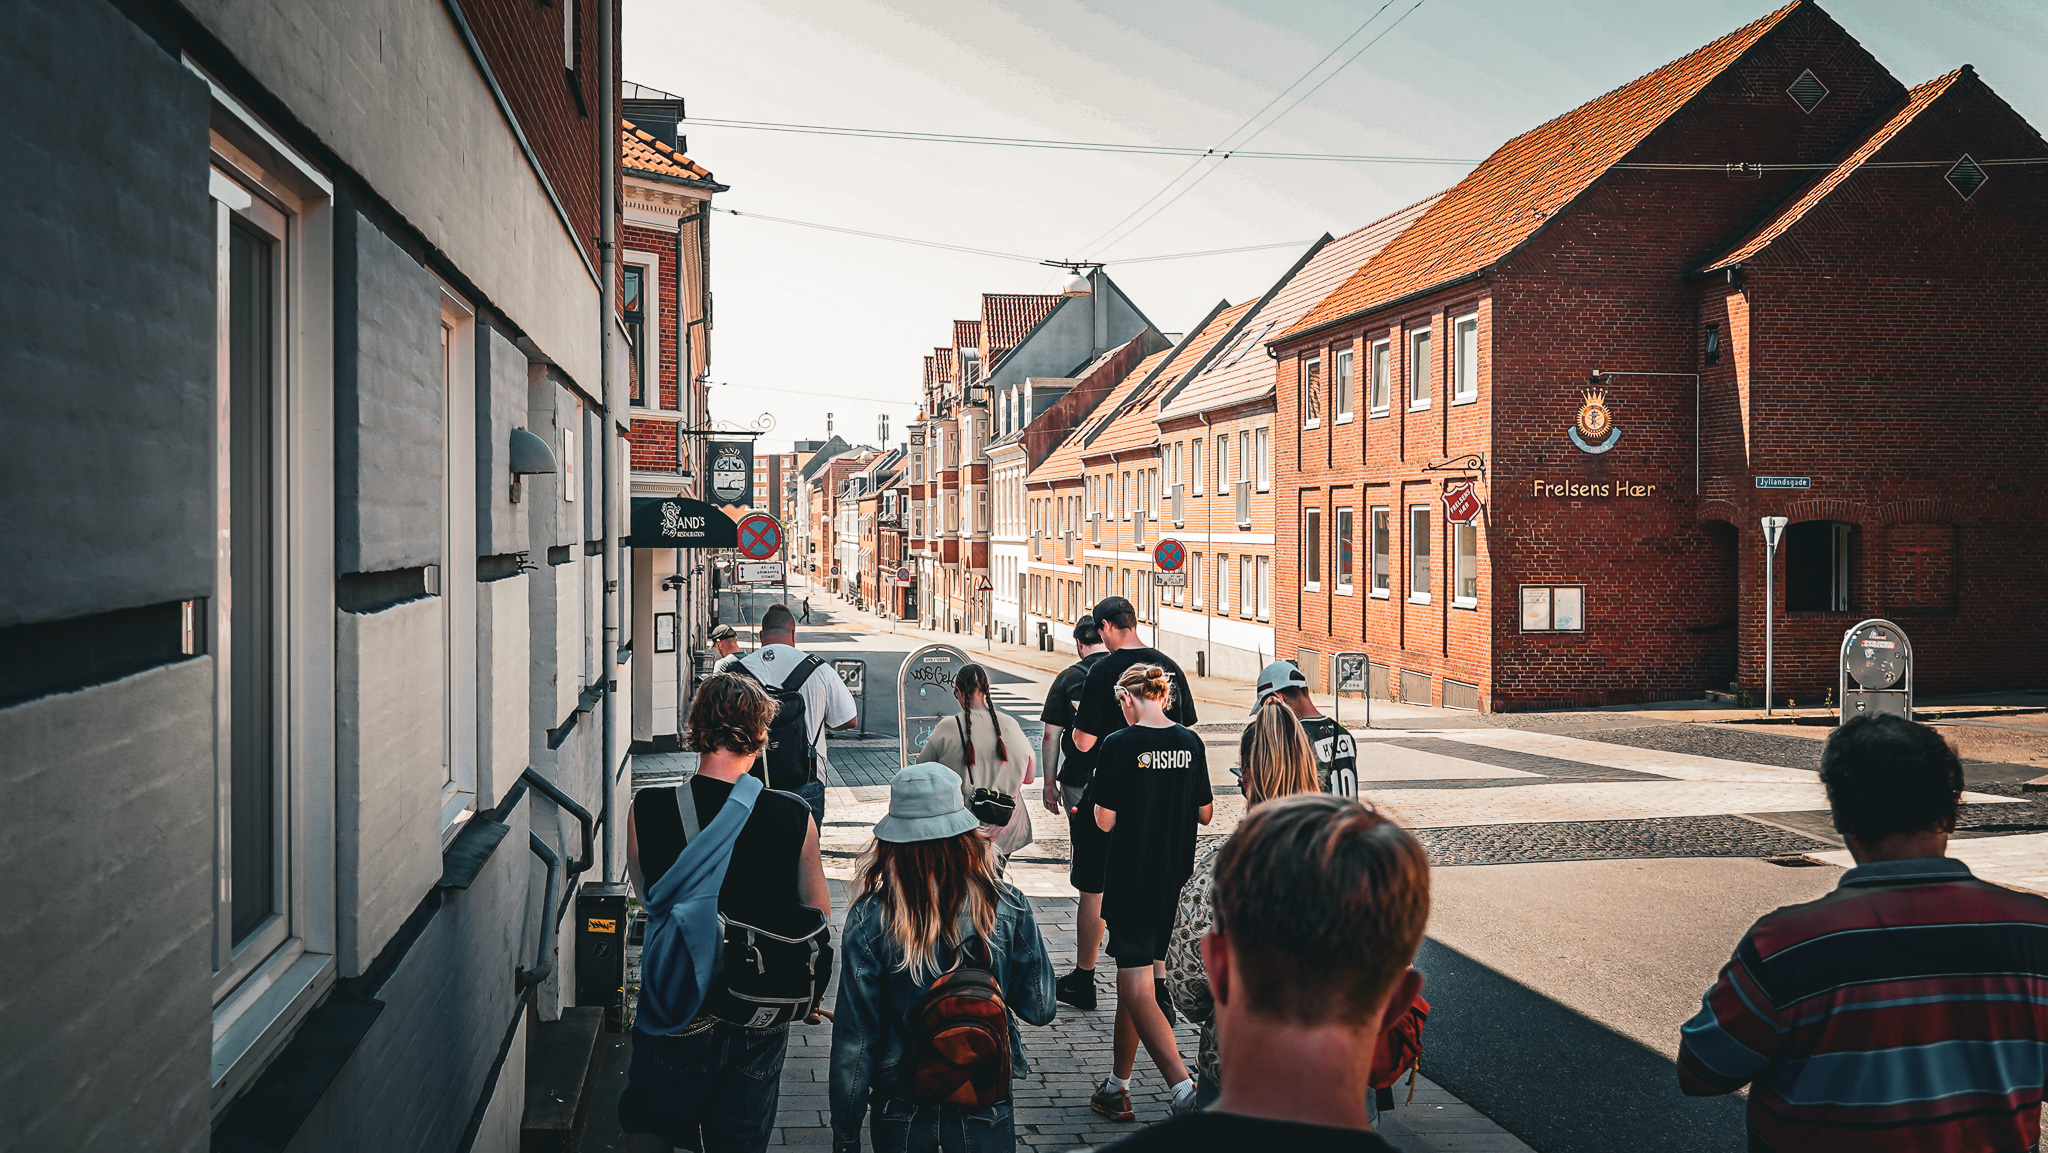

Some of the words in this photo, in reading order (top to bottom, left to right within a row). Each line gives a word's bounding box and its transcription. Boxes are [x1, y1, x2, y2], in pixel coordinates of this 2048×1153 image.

[1533, 479, 1610, 498] Frelsens
[1616, 480, 1656, 497] Hær
[1760, 478, 1807, 487] Jyllandsgade
[1450, 488, 1471, 513] FRELSENS
[1458, 502, 1470, 515] HÆR
[666, 508, 706, 529] SAND'S
[839, 669, 858, 682] 30
